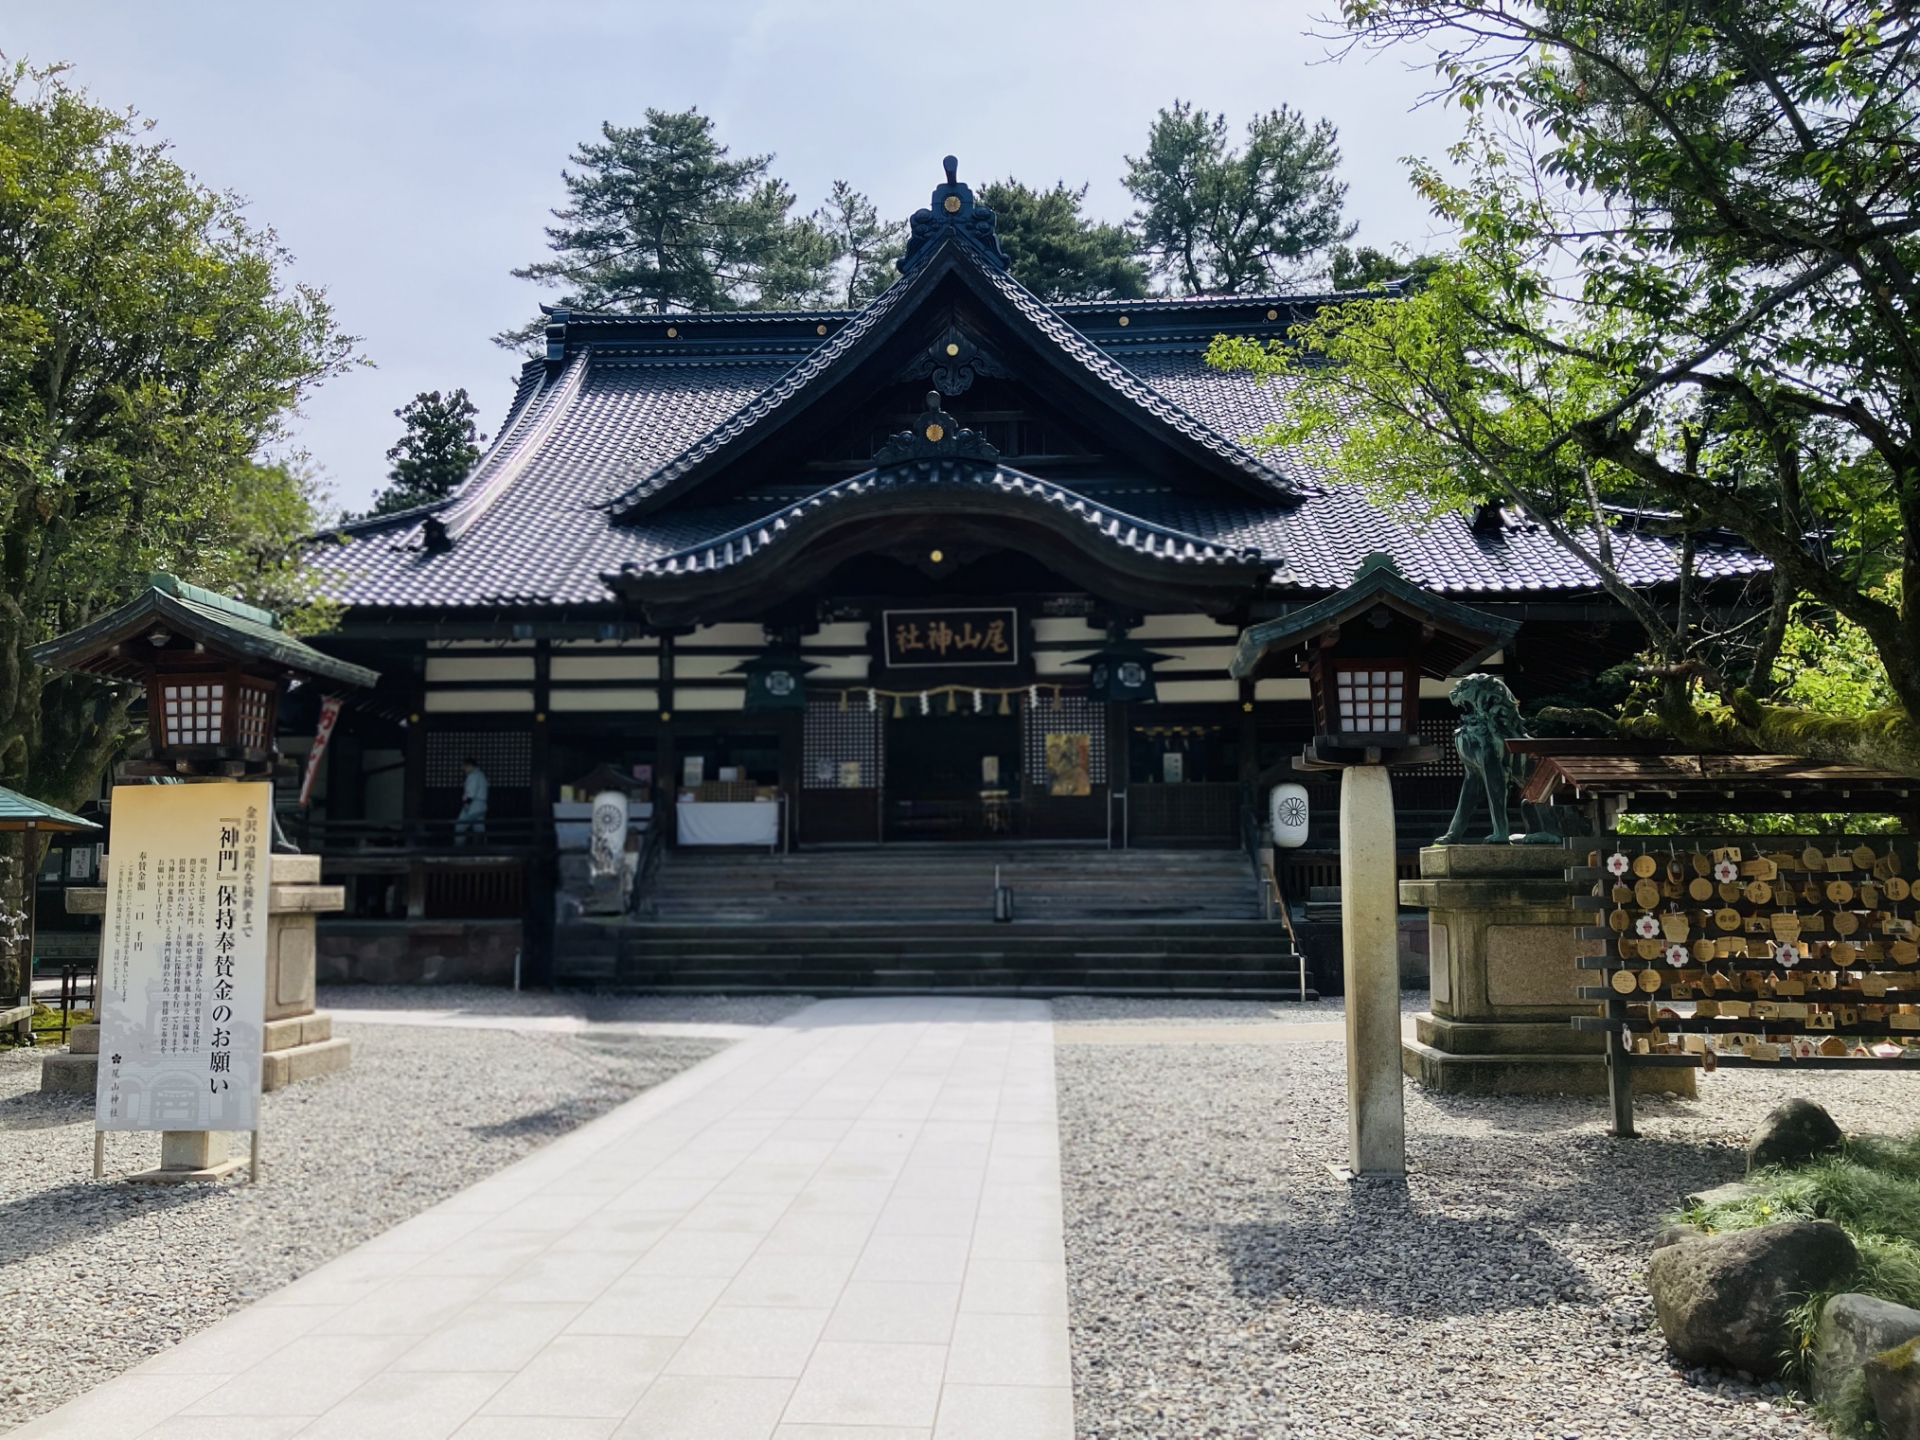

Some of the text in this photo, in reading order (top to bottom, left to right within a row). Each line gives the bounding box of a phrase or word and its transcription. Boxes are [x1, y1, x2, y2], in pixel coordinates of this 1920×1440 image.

[136, 851, 147, 891] 奉賛金額
[133, 931, 144, 952] 千円
[209, 817, 241, 1094] 『神門』保持奉賛金のお願い
[110, 1068, 120, 1118] 尾山神社
